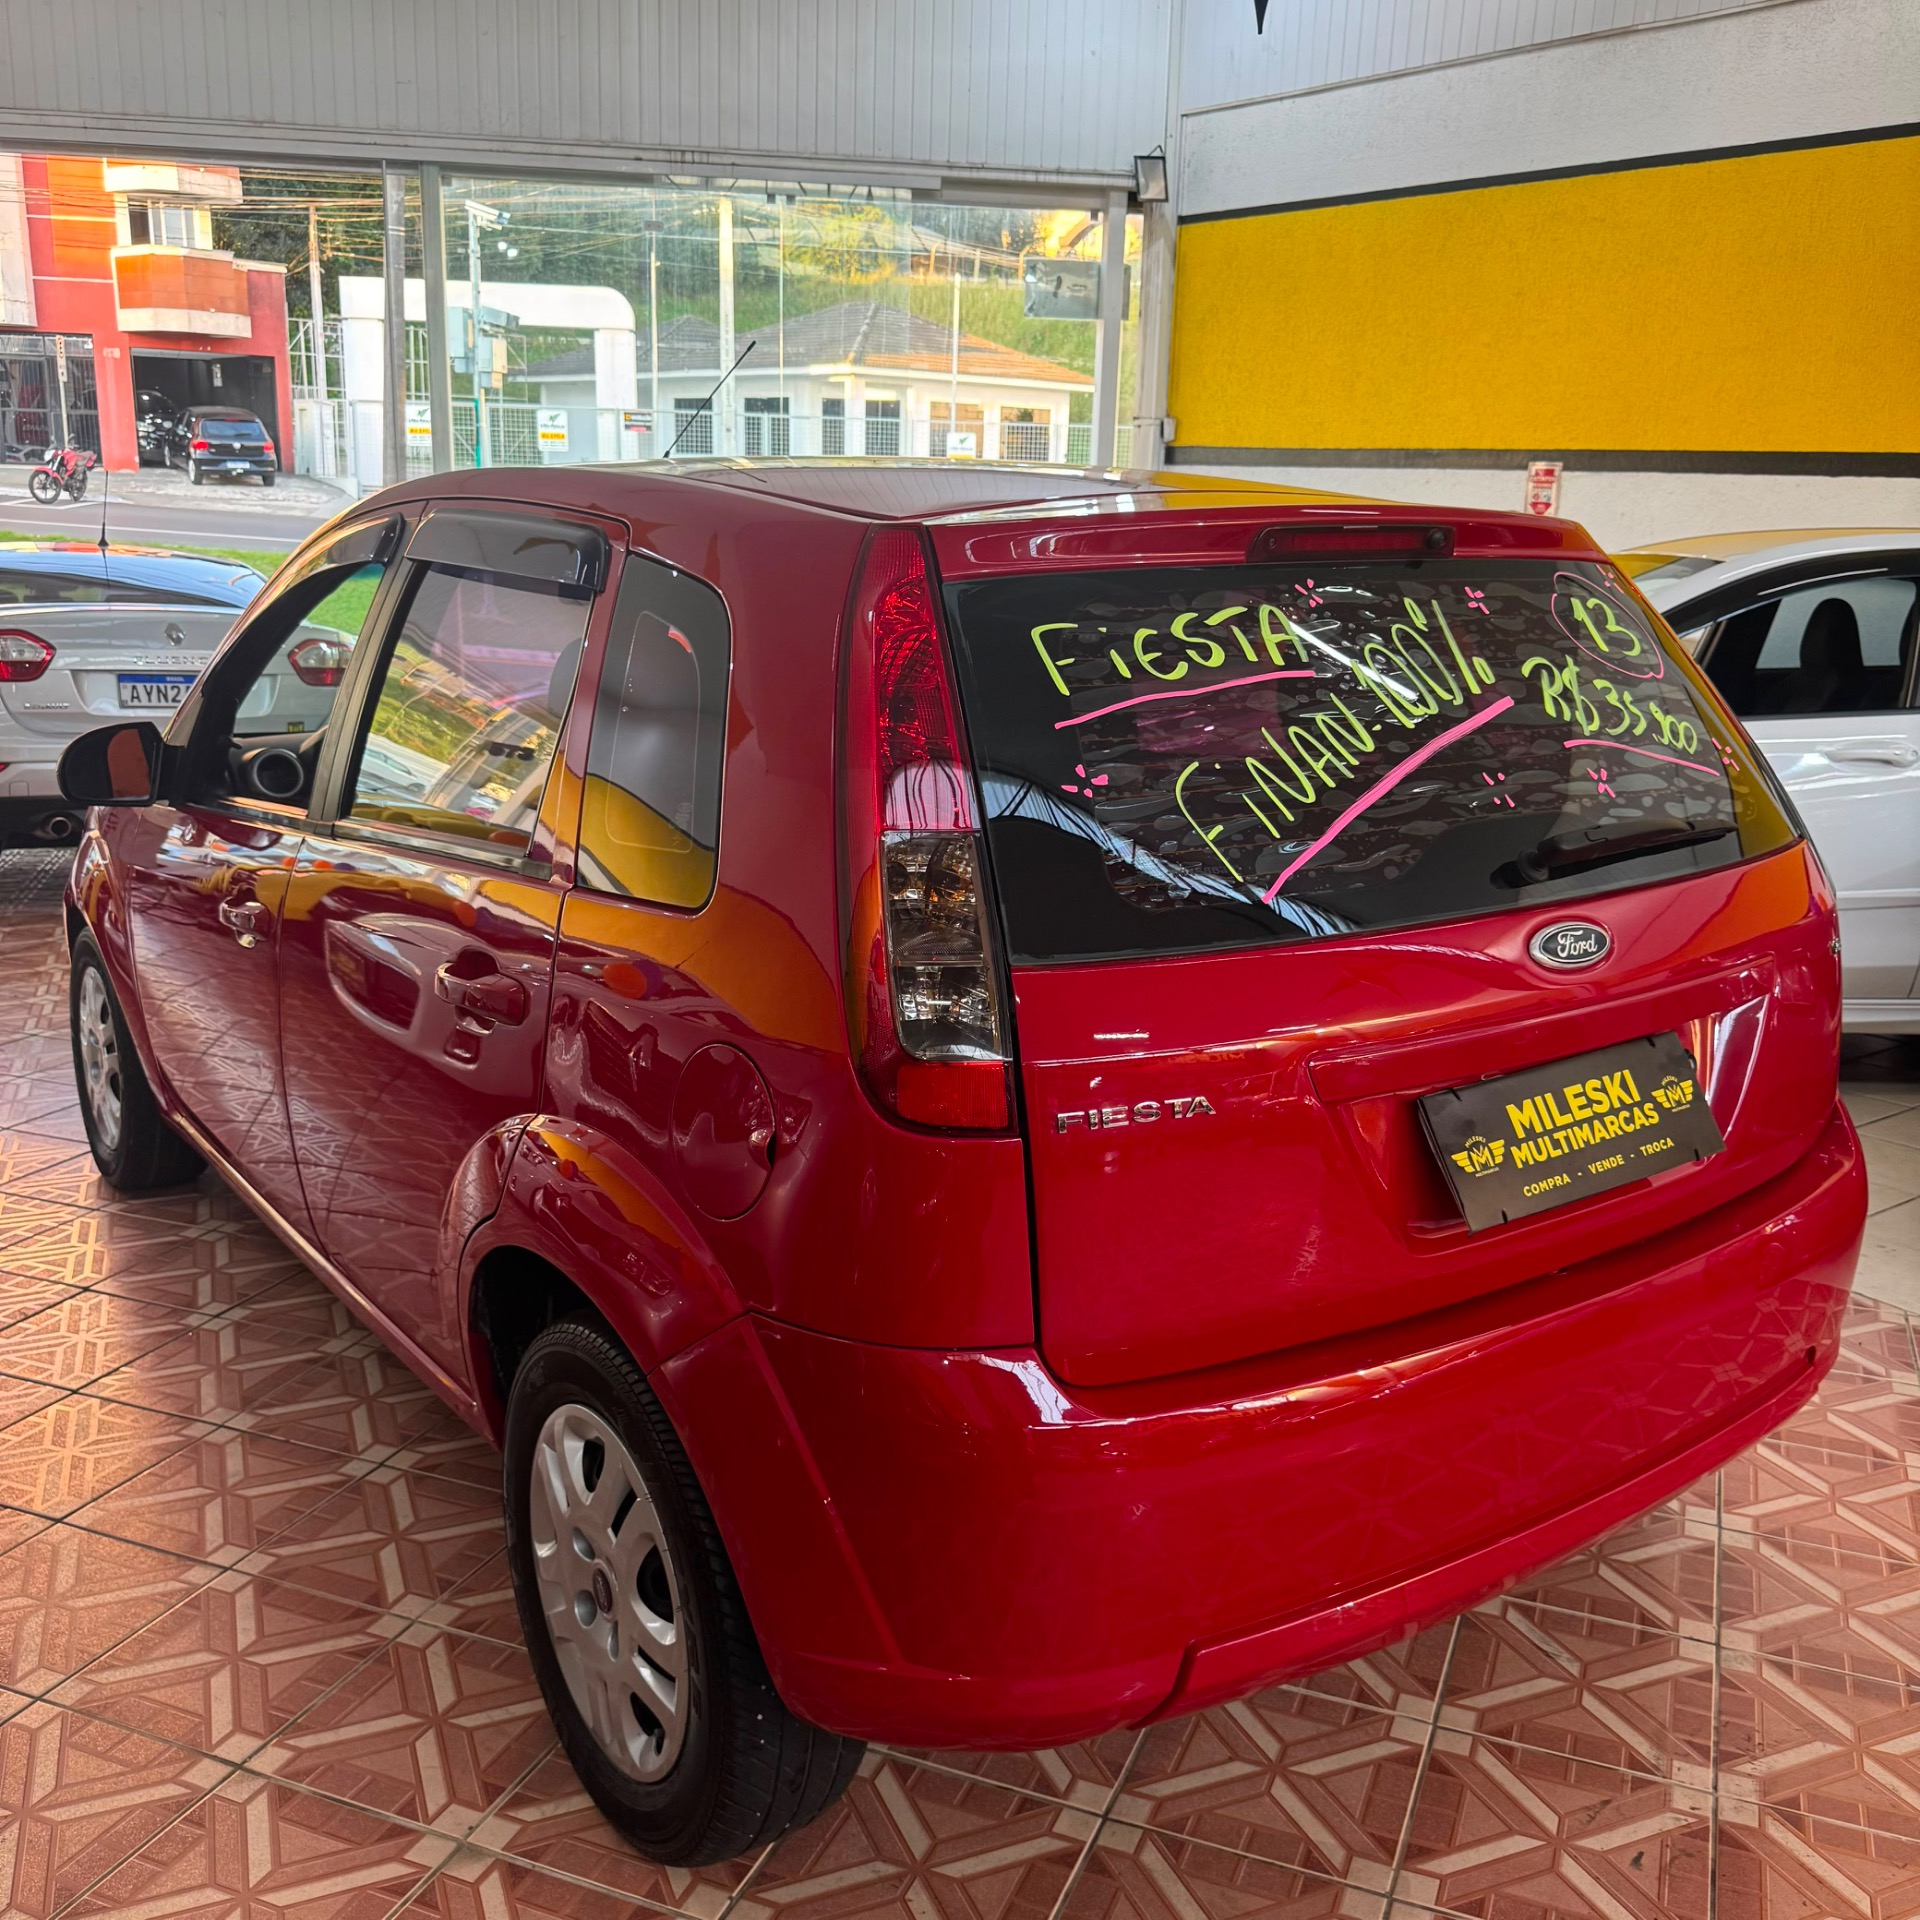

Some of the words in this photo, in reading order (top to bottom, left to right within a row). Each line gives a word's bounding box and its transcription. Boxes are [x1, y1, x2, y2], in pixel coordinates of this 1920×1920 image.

[1570, 597, 1641, 656] 13
[133, 656, 209, 666] FLUENC
[130, 684, 190, 703] AYN2
[1557, 931, 1598, 956] Ford
[1057, 1096, 1216, 1133] FIESTA
[1505, 1068, 1641, 1139] MILESKI
[1510, 1102, 1659, 1169] MULTIMARCAS
[1523, 1173, 1571, 1197] COMPRA
[1588, 1153, 1625, 1175] VENDE
[1640, 1137, 1675, 1157] TROCA
